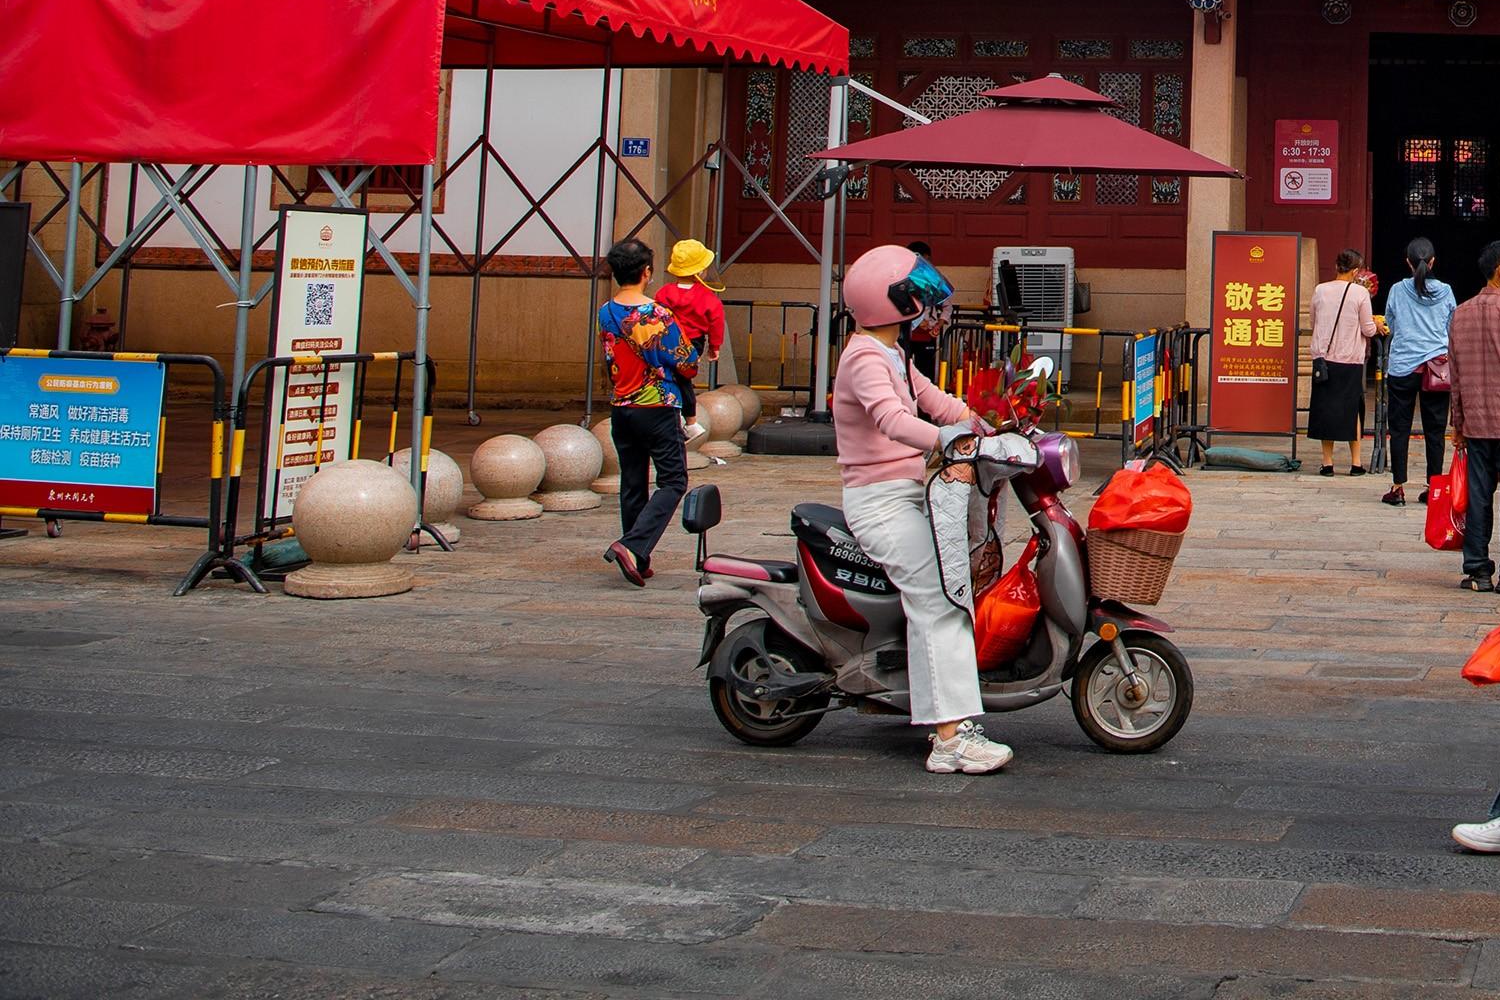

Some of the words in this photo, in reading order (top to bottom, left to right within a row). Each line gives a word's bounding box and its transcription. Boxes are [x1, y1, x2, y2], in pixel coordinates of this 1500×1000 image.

[1282, 147, 1301, 156] 6:30
[1307, 147, 1331, 156] 17:30
[1225, 282, 1286, 311] 敬老
[1223, 318, 1285, 347] 通道
[29, 403, 59, 420] 常通风
[67, 404, 129, 424] 做好清洁消毒
[0, 423, 62, 442] 保持厕所卫生
[69, 427, 152, 448] 养成健康生活方式
[30, 448, 72, 466] 核酸检测
[79, 451, 121, 469] 疫苗接种
